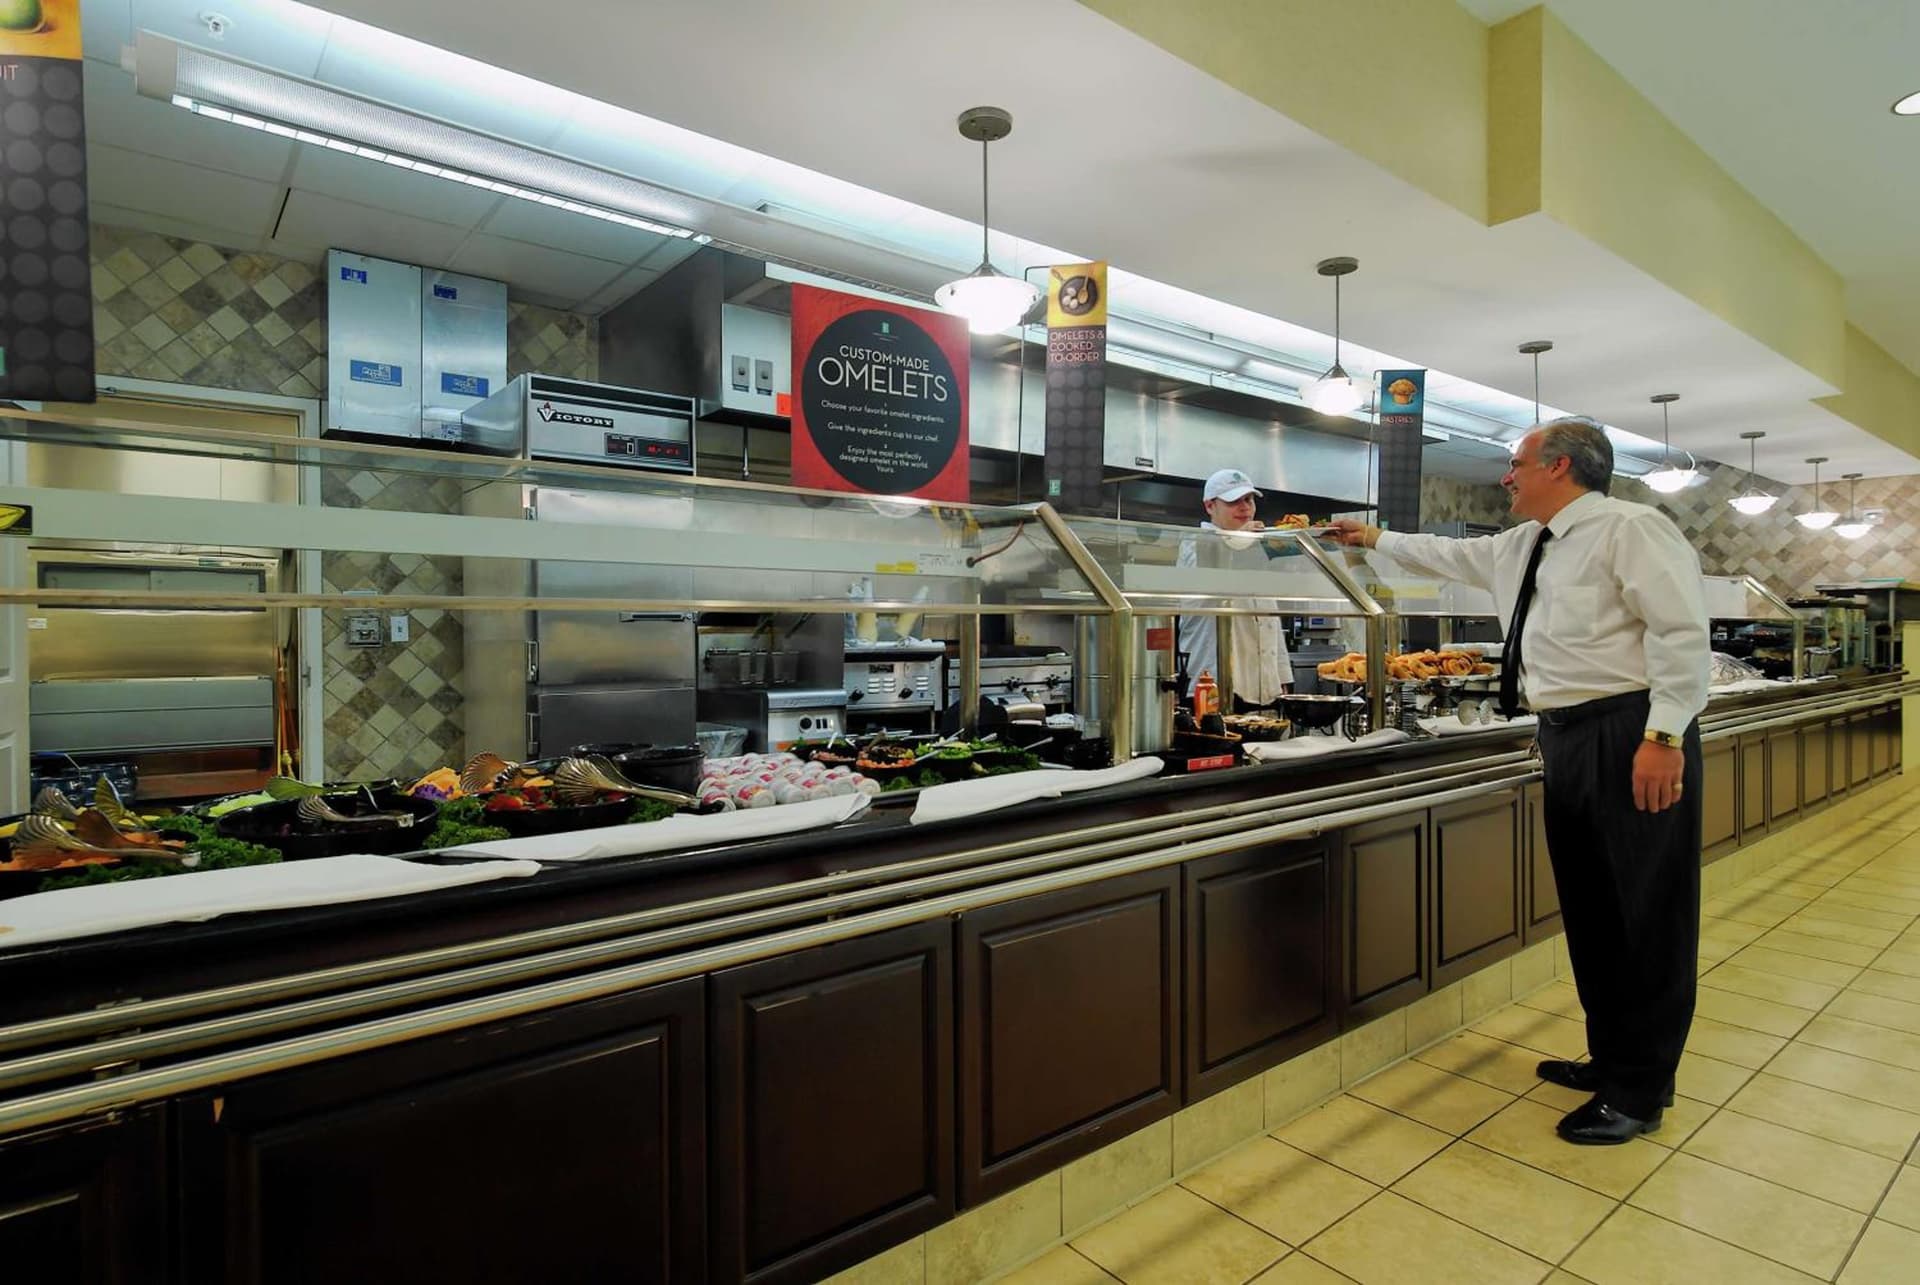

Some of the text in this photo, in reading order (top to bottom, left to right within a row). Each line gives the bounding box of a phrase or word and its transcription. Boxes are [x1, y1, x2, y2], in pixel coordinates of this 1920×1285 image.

[1050, 330, 1104, 341] OMELETS &
[839, 345, 930, 371] CUSTOM-MADE
[1050, 352, 1099, 362] TO-ORDER
[818, 356, 948, 401] OMELETS
[821, 400, 846, 410] Choose
[864, 404, 888, 415] favorite
[889, 410, 910, 418] omelet
[827, 421, 843, 431] Give
[857, 426, 892, 436] ingredients
[893, 431, 905, 439] cup
[839, 452, 869, 463] designed
[870, 456, 891, 464] omelet
[847, 445, 865, 455] Enjoy
[866, 448, 877, 456] the
[895, 451, 922, 461] perfectly
